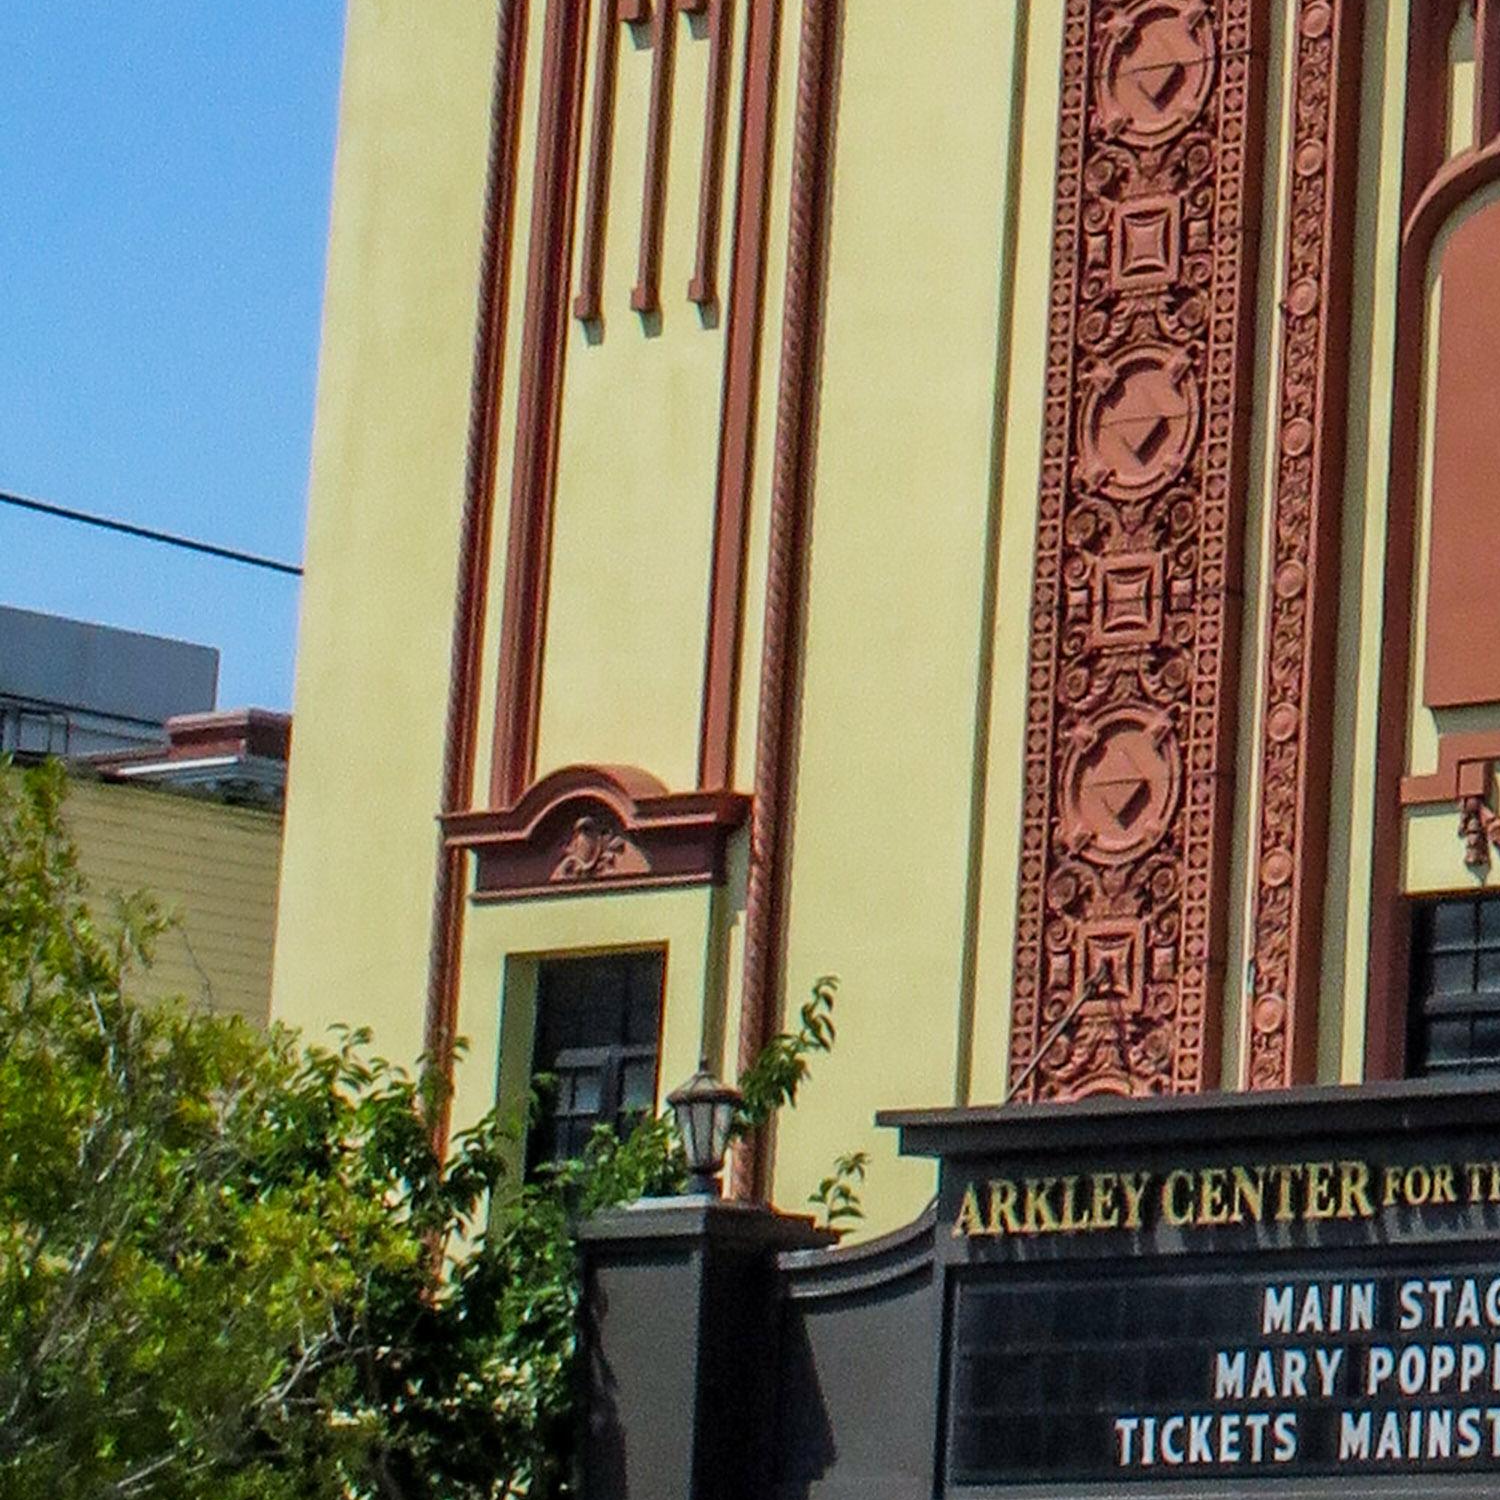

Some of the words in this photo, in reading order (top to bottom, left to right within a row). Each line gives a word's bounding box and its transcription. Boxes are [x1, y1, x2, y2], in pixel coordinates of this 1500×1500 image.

[953, 1171, 1152, 1238] ARKLEY
[1160, 1161, 1374, 1226] CENTER
[1381, 1163, 1456, 1206] FOR
[1262, 1281, 1376, 1335] MAIN
[1213, 1349, 1344, 1400] MARY
[1114, 1412, 1298, 1466] TICKETS
